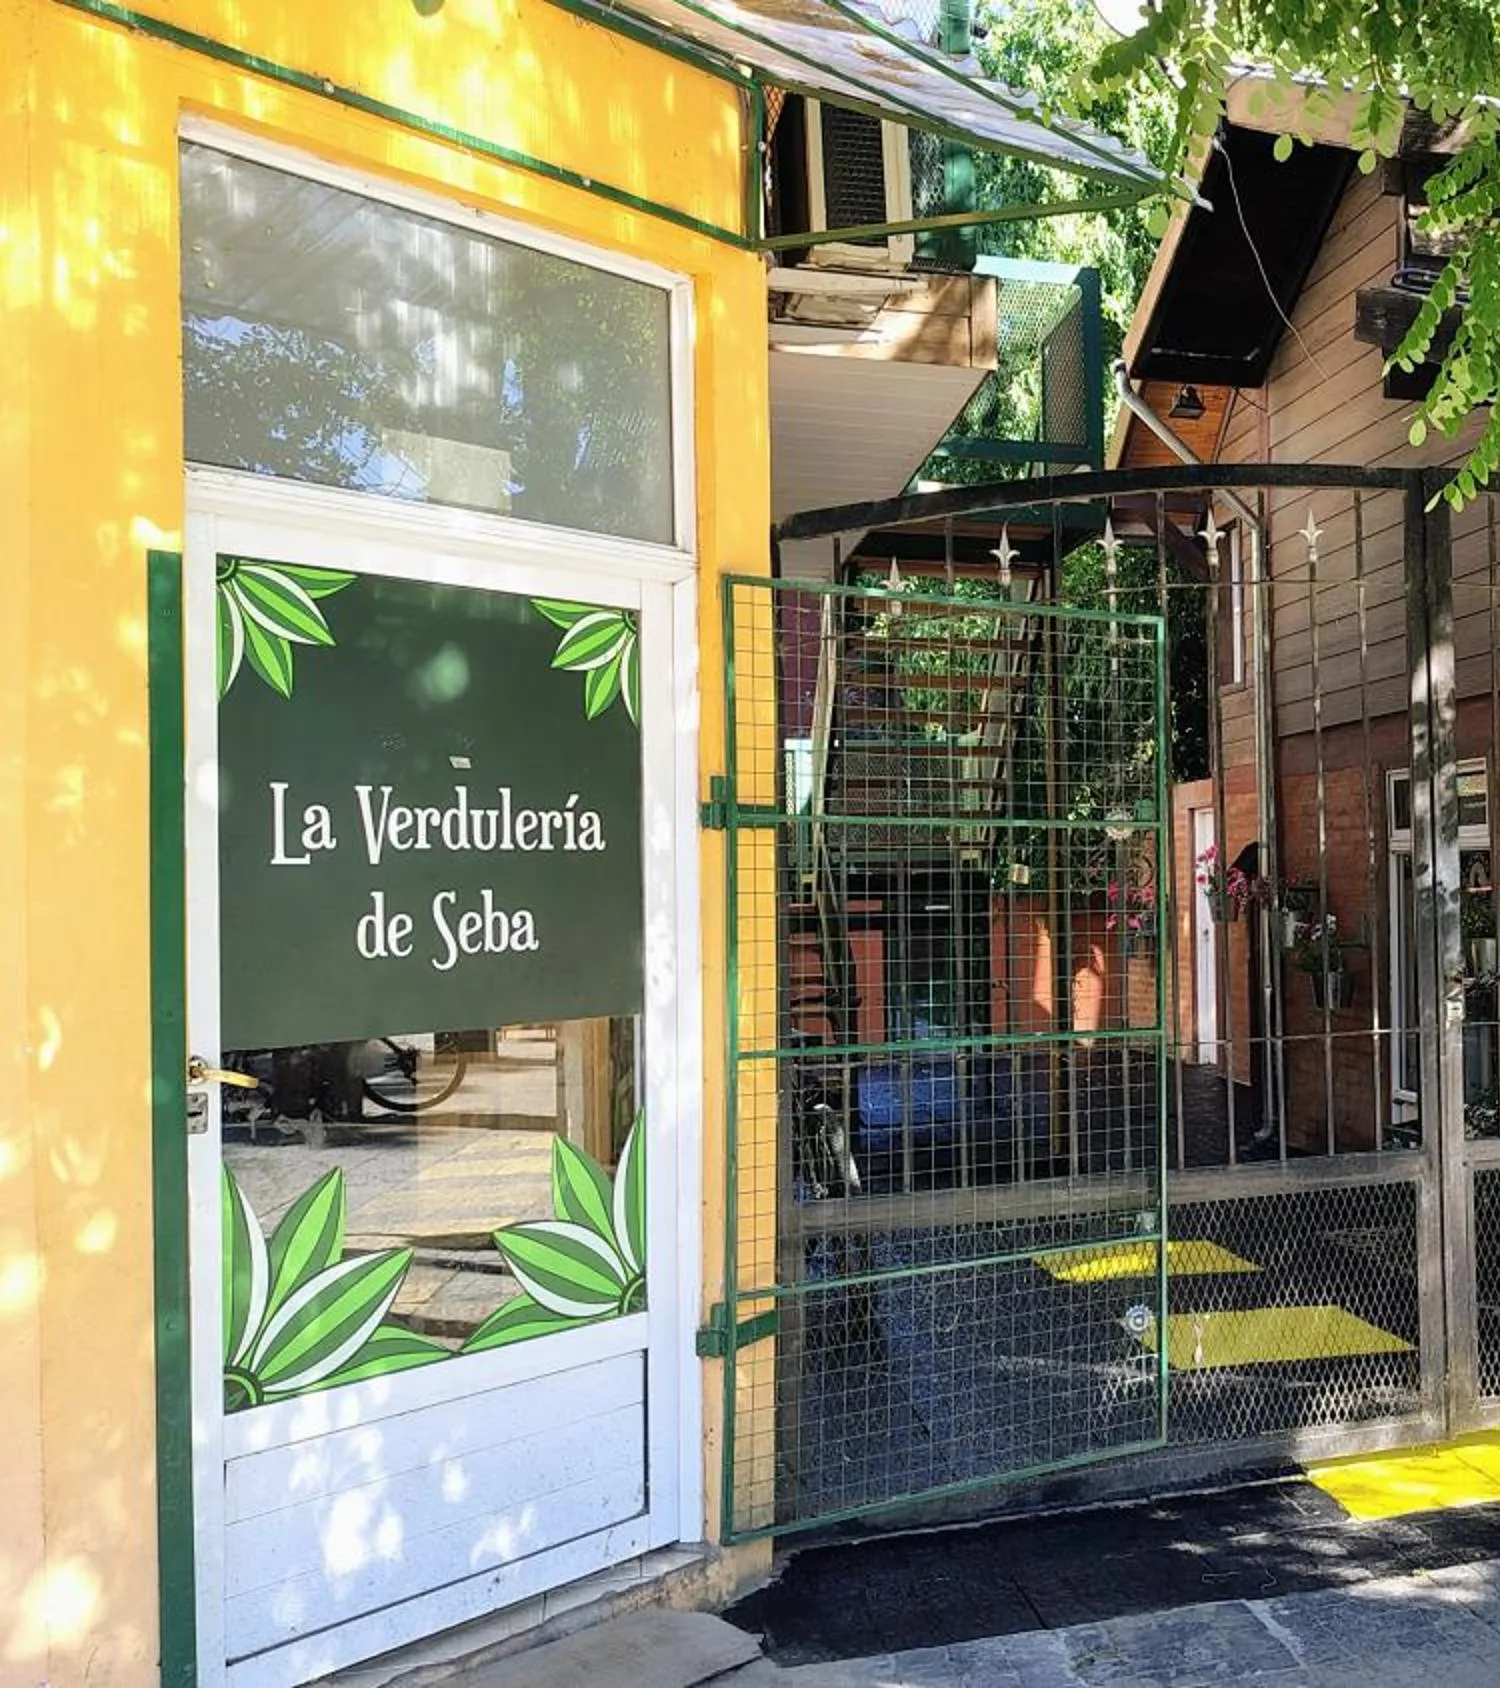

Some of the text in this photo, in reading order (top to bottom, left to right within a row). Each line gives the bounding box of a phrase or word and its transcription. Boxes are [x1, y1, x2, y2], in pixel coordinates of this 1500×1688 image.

[269, 781, 606, 866] La Verdulería
[356, 889, 540, 971] de Seba
